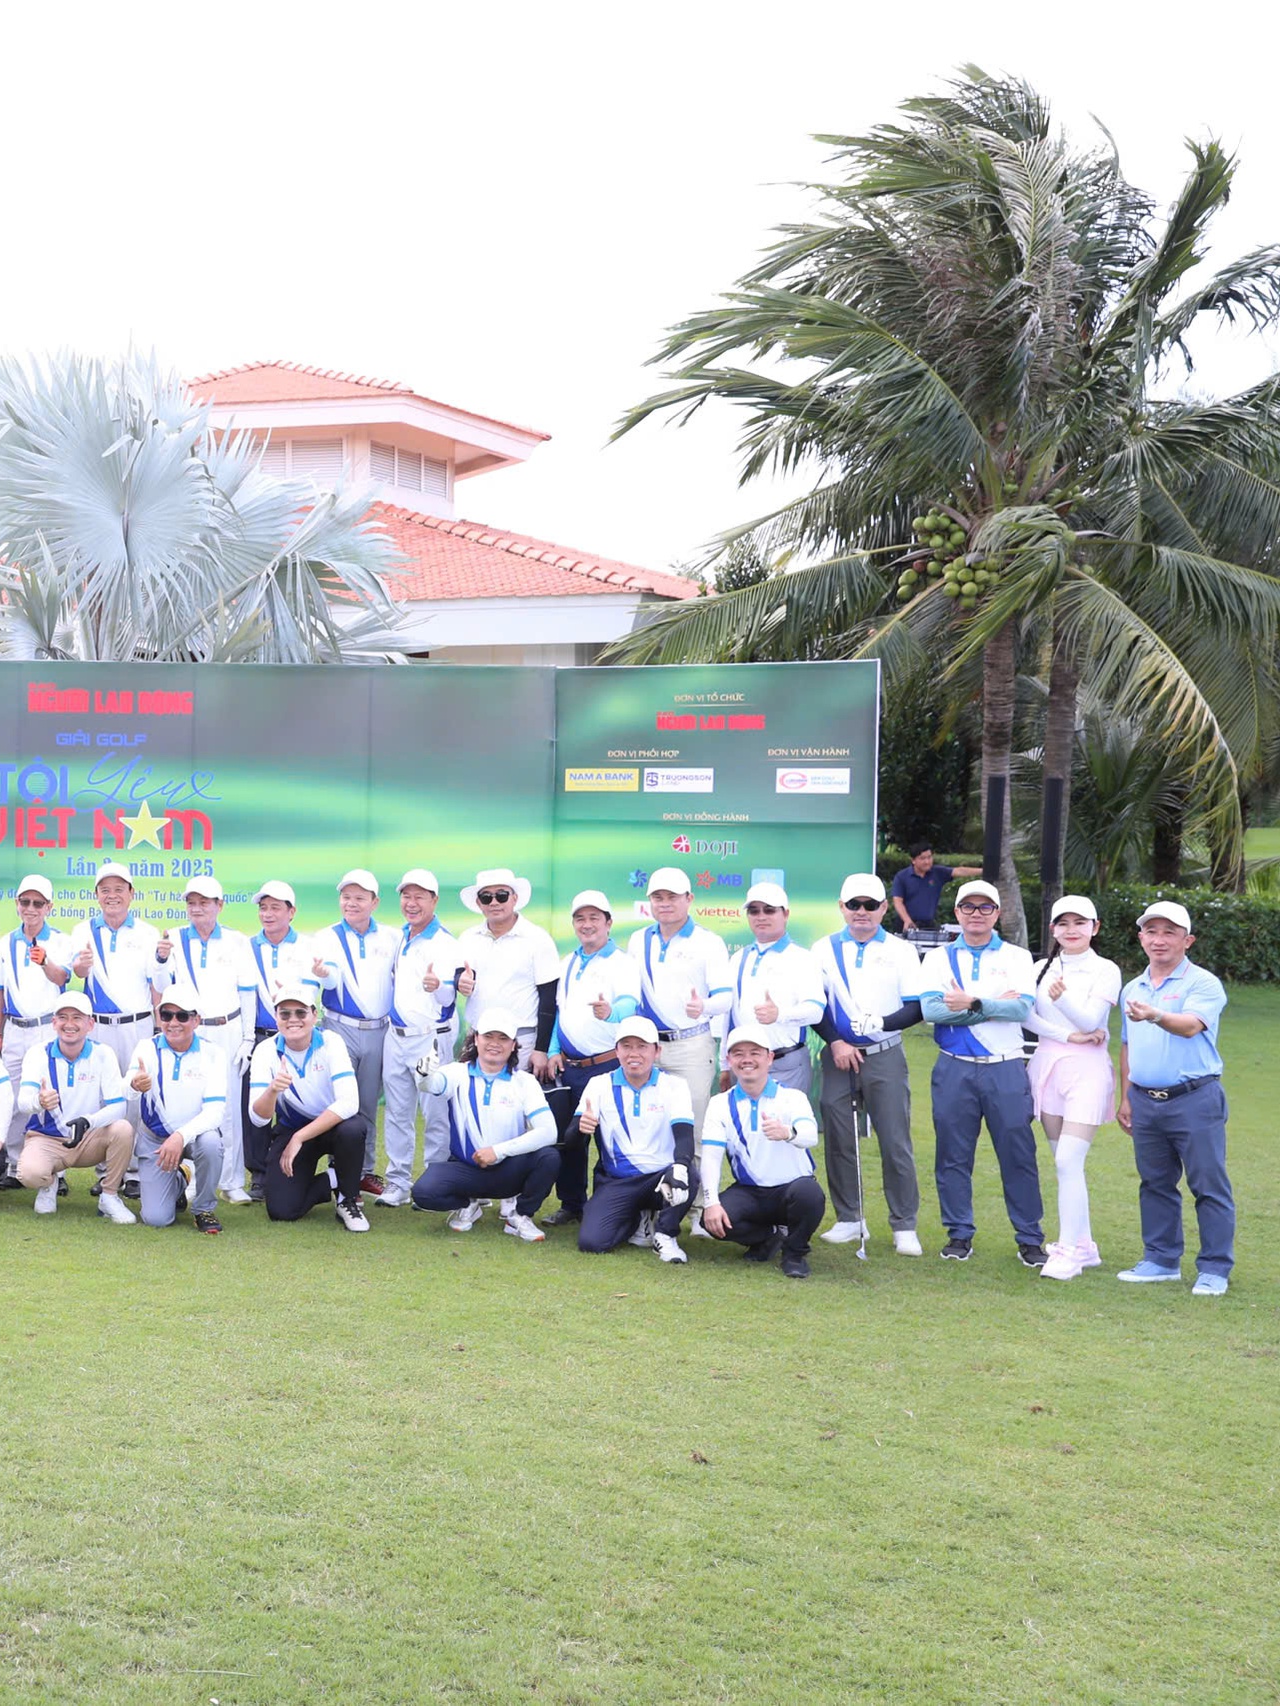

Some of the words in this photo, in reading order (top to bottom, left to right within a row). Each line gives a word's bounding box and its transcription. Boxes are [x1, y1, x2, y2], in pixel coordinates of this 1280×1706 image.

[96, 733, 147, 746] GOLF
[604, 773, 633, 781] BANK
[696, 840, 738, 860] DOJI
[67, 856, 96, 876] Lần
[129, 858, 164, 877] năm
[171, 858, 214, 877] 2025
[717, 874, 743, 887] MB
[58, 890, 76, 900] cho
[61, 905, 85, 919] bổng
[145, 908, 163, 919] Lao
[166, 908, 187, 921] Độn
[696, 907, 741, 918] viettel
